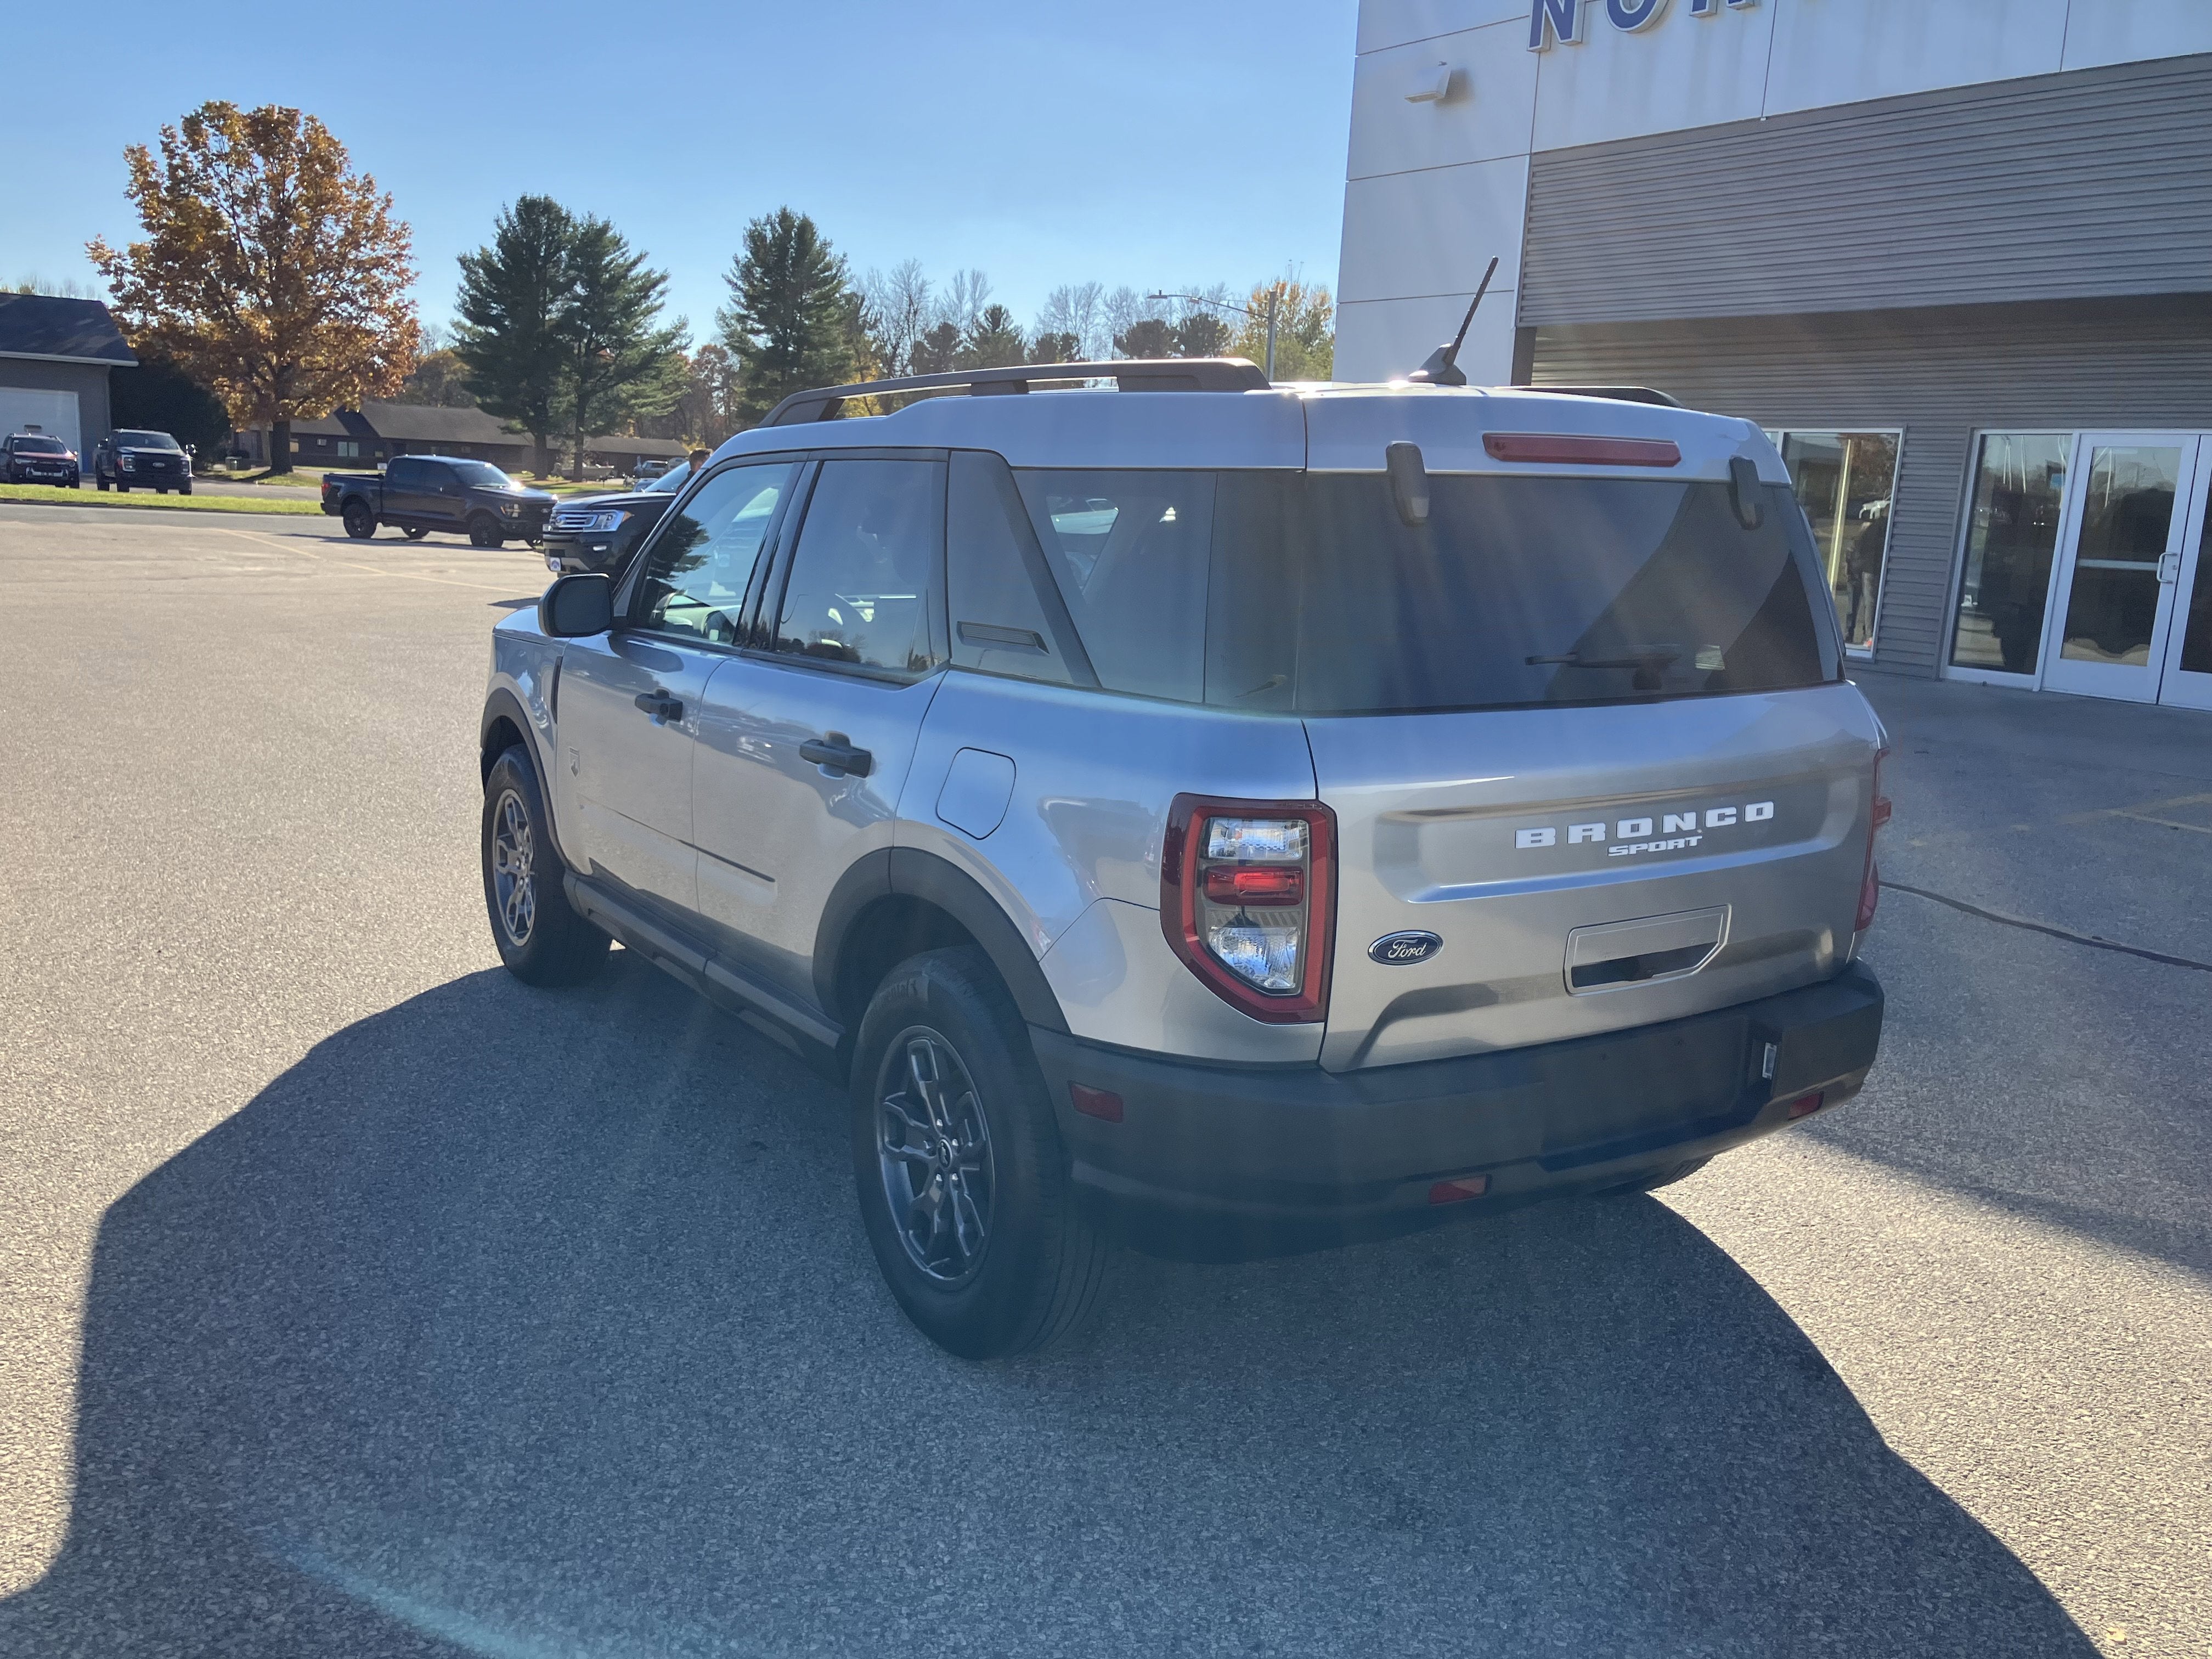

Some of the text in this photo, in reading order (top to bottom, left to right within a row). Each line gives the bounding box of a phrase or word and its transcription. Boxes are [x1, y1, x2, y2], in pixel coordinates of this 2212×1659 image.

[1527, 0, 1755, 53] NO
[1515, 801, 1774, 849] BRONCO
[1607, 835, 1702, 856] SPORT
[1387, 939, 1427, 958] Ford
